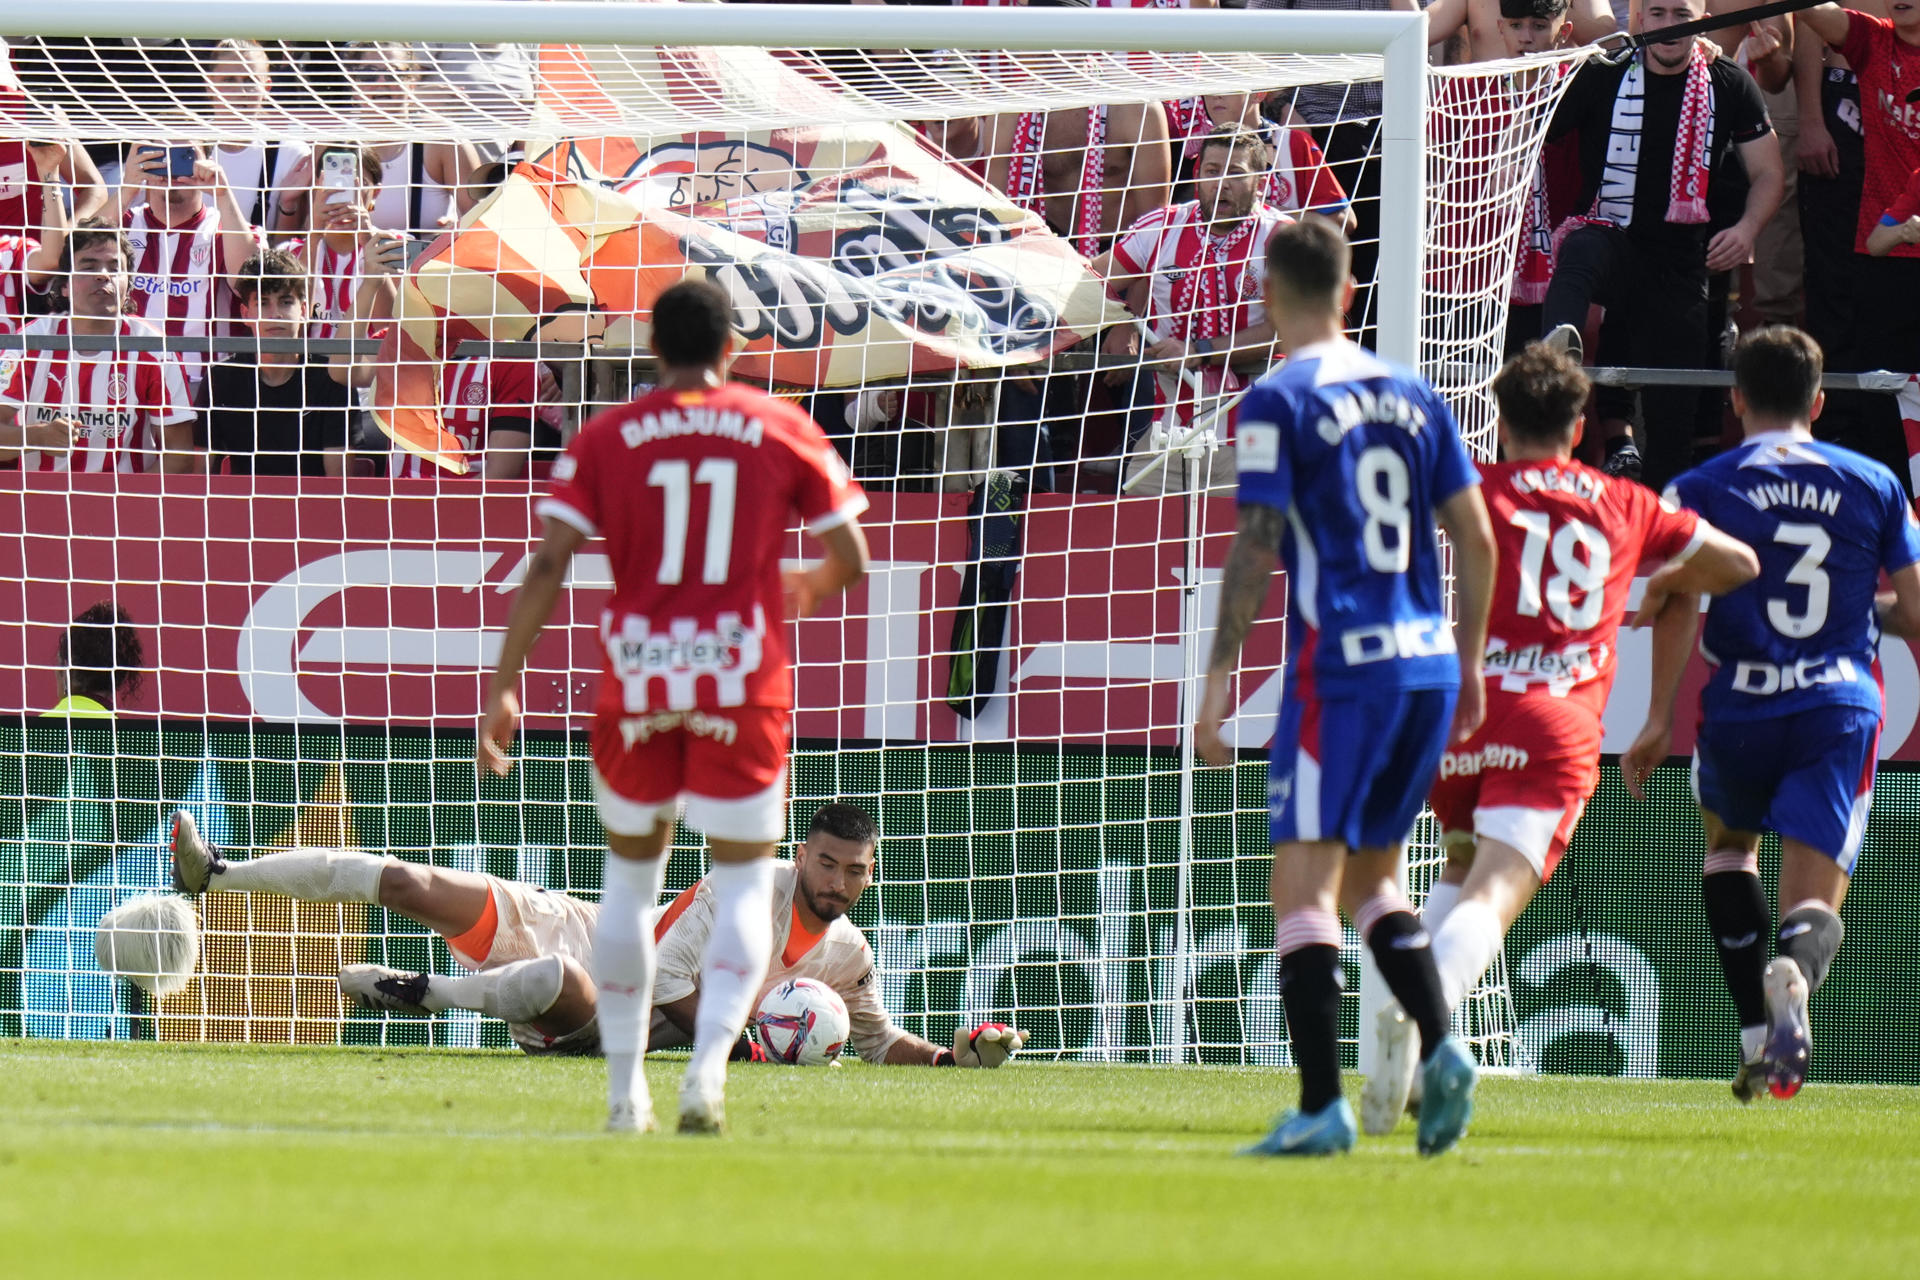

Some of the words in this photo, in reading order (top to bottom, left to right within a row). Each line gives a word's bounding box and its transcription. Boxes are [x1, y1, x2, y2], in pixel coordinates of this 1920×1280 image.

[134, 276, 201, 295] etronor
[620, 406, 764, 449] DANJUMA
[1356, 446, 1410, 573] 8
[1746, 480, 1841, 516] VIVIAN
[647, 457, 738, 585] 11
[1509, 509, 1612, 631] 18
[1767, 521, 1832, 639] 3
[1731, 656, 1858, 695] DIGI
[1439, 742, 1529, 781] parem
